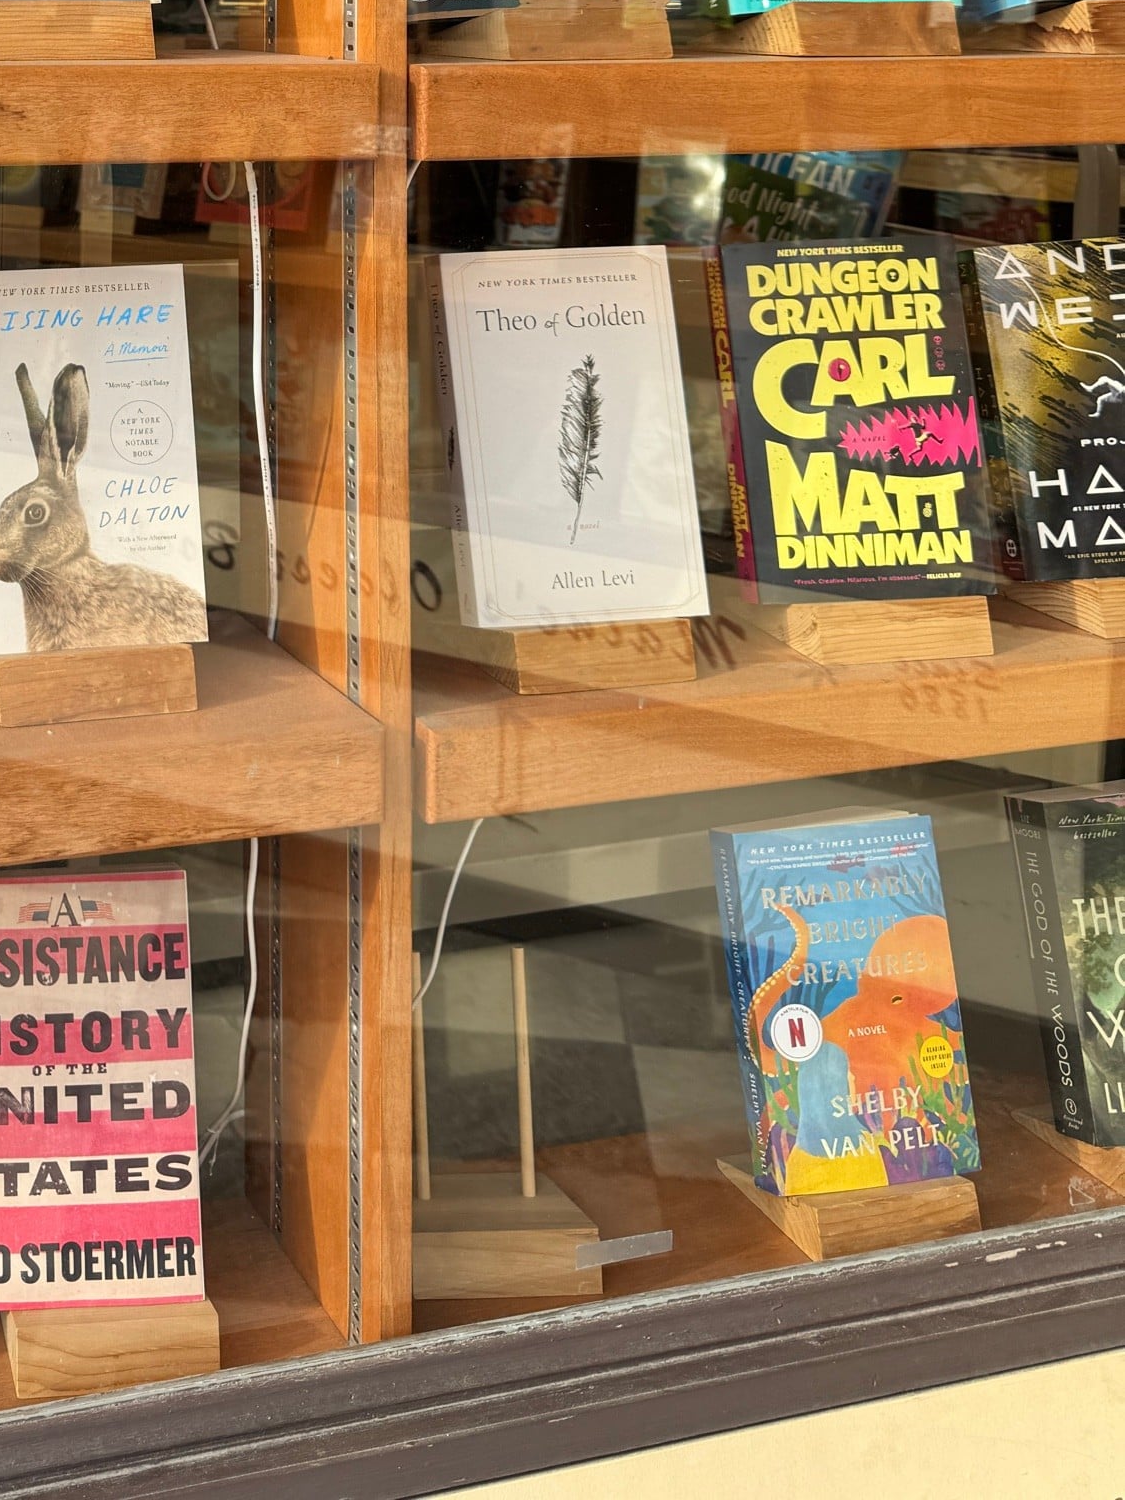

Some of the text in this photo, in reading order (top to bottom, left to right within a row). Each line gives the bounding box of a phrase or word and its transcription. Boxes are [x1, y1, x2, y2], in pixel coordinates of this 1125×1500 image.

[746, 257, 939, 298] DUNGEON
[97, 304, 174, 327] HARE
[476, 303, 646, 337] Theo of Golden
[749, 293, 944, 336] CRAWLER
[752, 333, 955, 440] CARL
[105, 476, 178, 498] CHLOE
[764, 439, 965, 537] MATT
[99, 504, 190, 528] DALTON
[776, 530, 973, 569] DINNIMAN
[551, 569, 635, 590] Allen Levi
[50, 892, 81, 927] A
[32, 1063, 107, 1076] OF THE
[830, 1086, 922, 1118] SHELBY
[822, 1123, 943, 1160] VAN PELT
[20, 1236, 196, 1283] STOERMER
